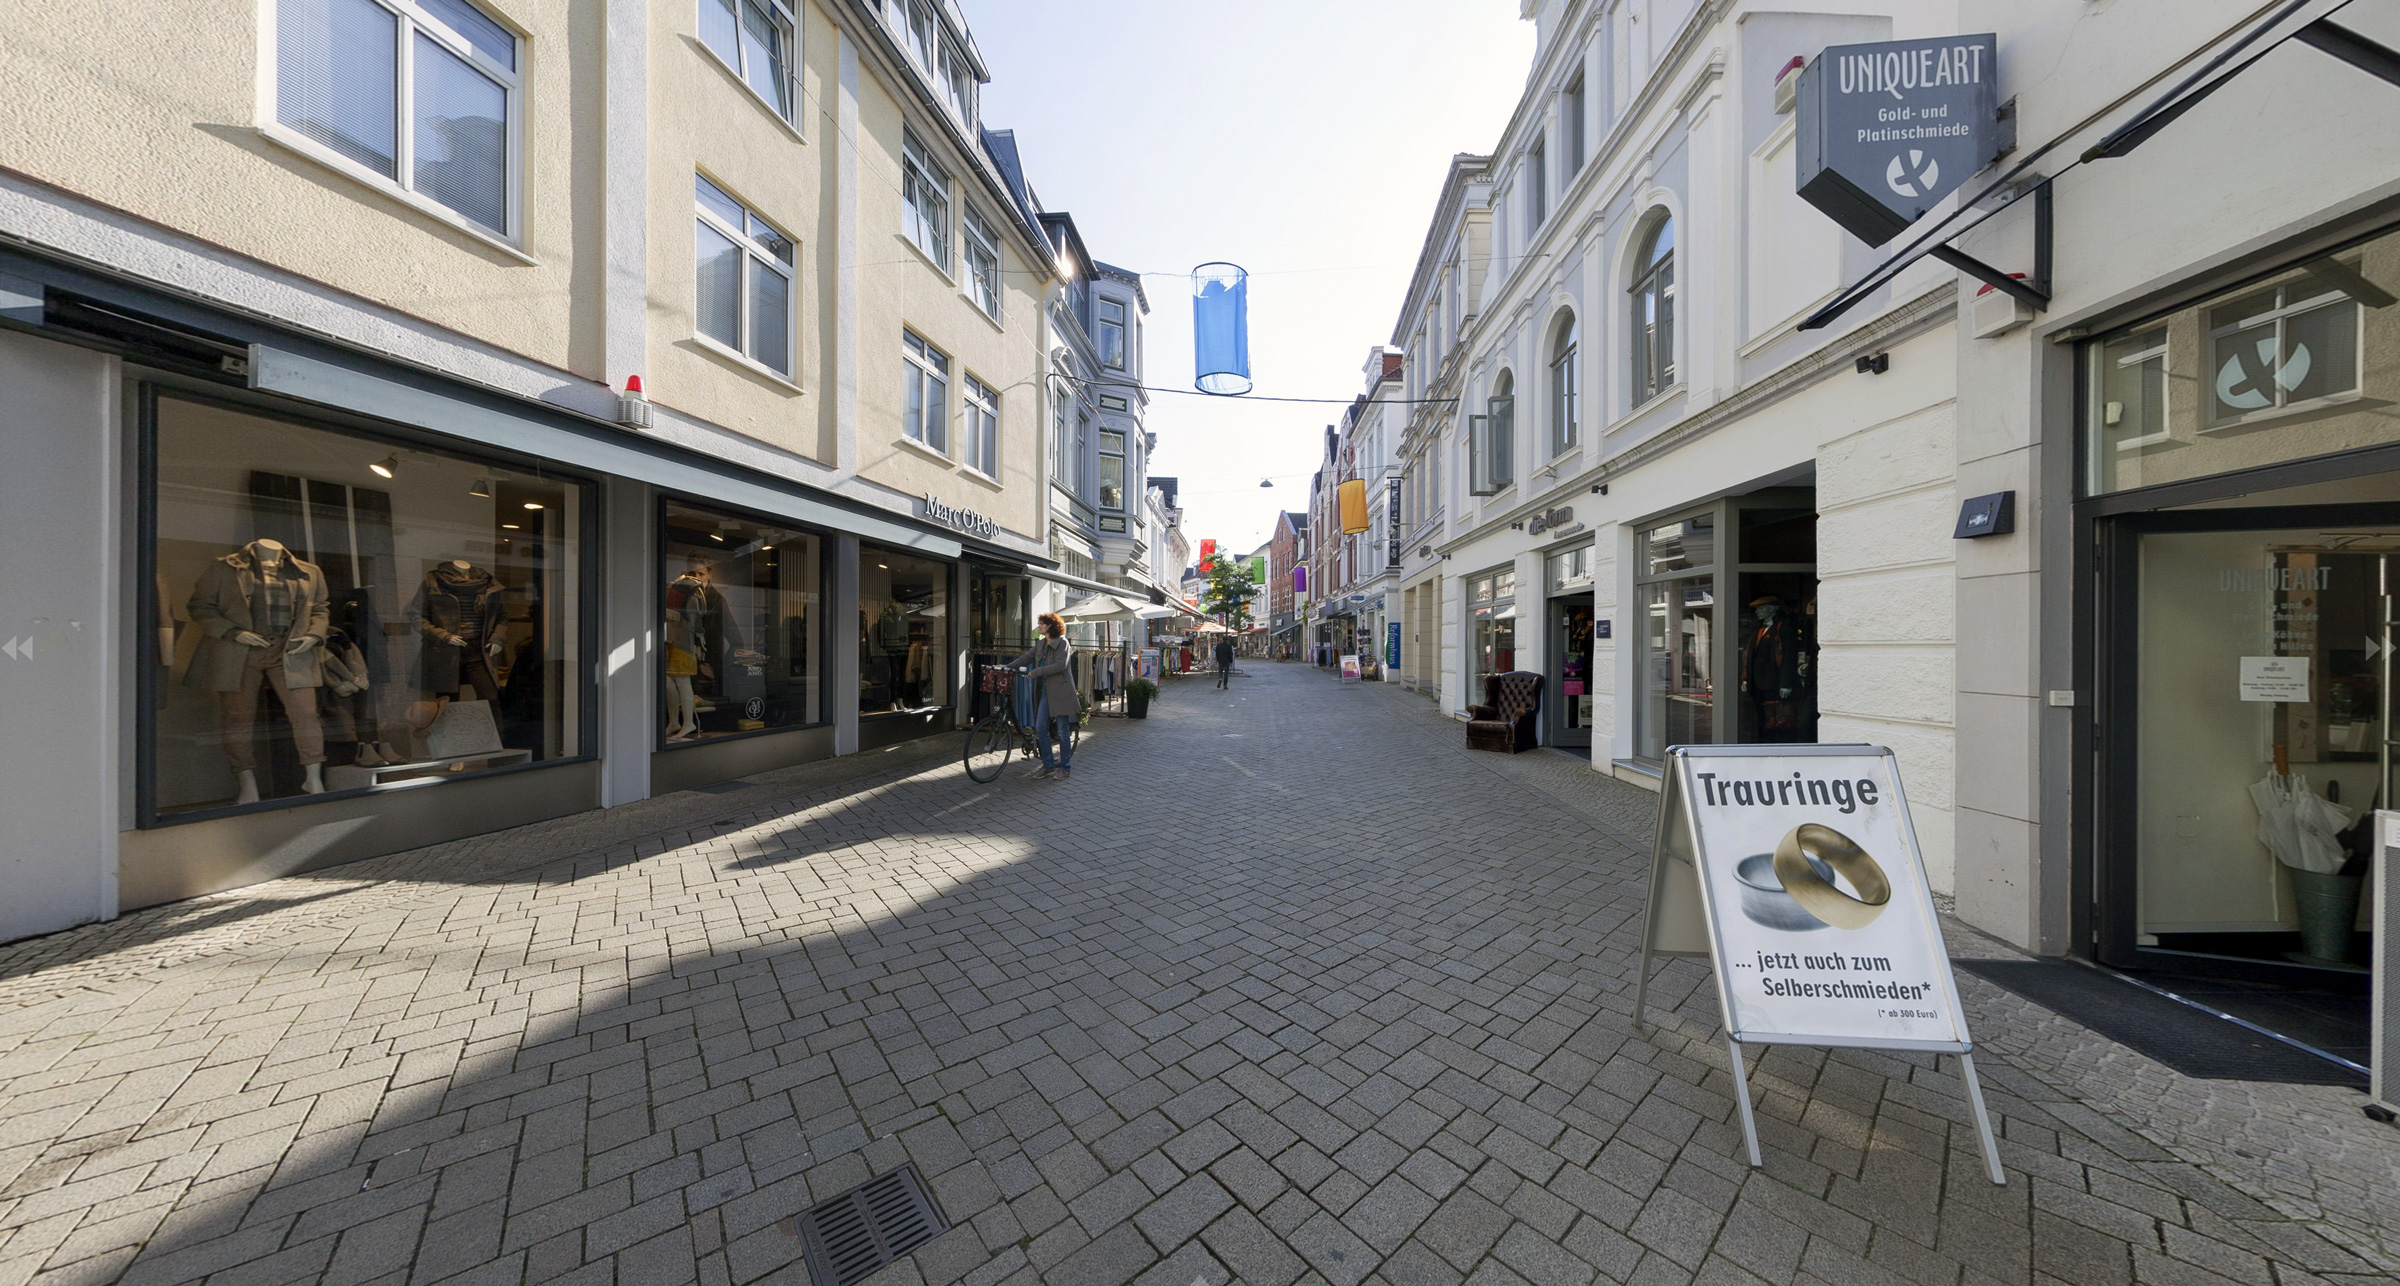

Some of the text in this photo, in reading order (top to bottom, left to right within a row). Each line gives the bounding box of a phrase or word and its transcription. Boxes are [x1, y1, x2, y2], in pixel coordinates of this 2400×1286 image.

[1838, 44, 1985, 100] UNIQUEART
[1877, 103, 1948, 123] Gold- und
[1856, 122, 1970, 143] Platinschmiede
[924, 492, 1001, 537] Marc O'Polo
[1388, 624, 1398, 665] Reformhaus
[1697, 771, 1880, 815] Trauringe
[1756, 951, 1800, 973] jetzt
[1804, 951, 1846, 971] auch
[1851, 956, 1892, 972] zum
[1888, 1008, 1898, 1018] ab
[1900, 1008, 1915, 1019] 300
[1916, 1008, 1938, 1020] Euro)
